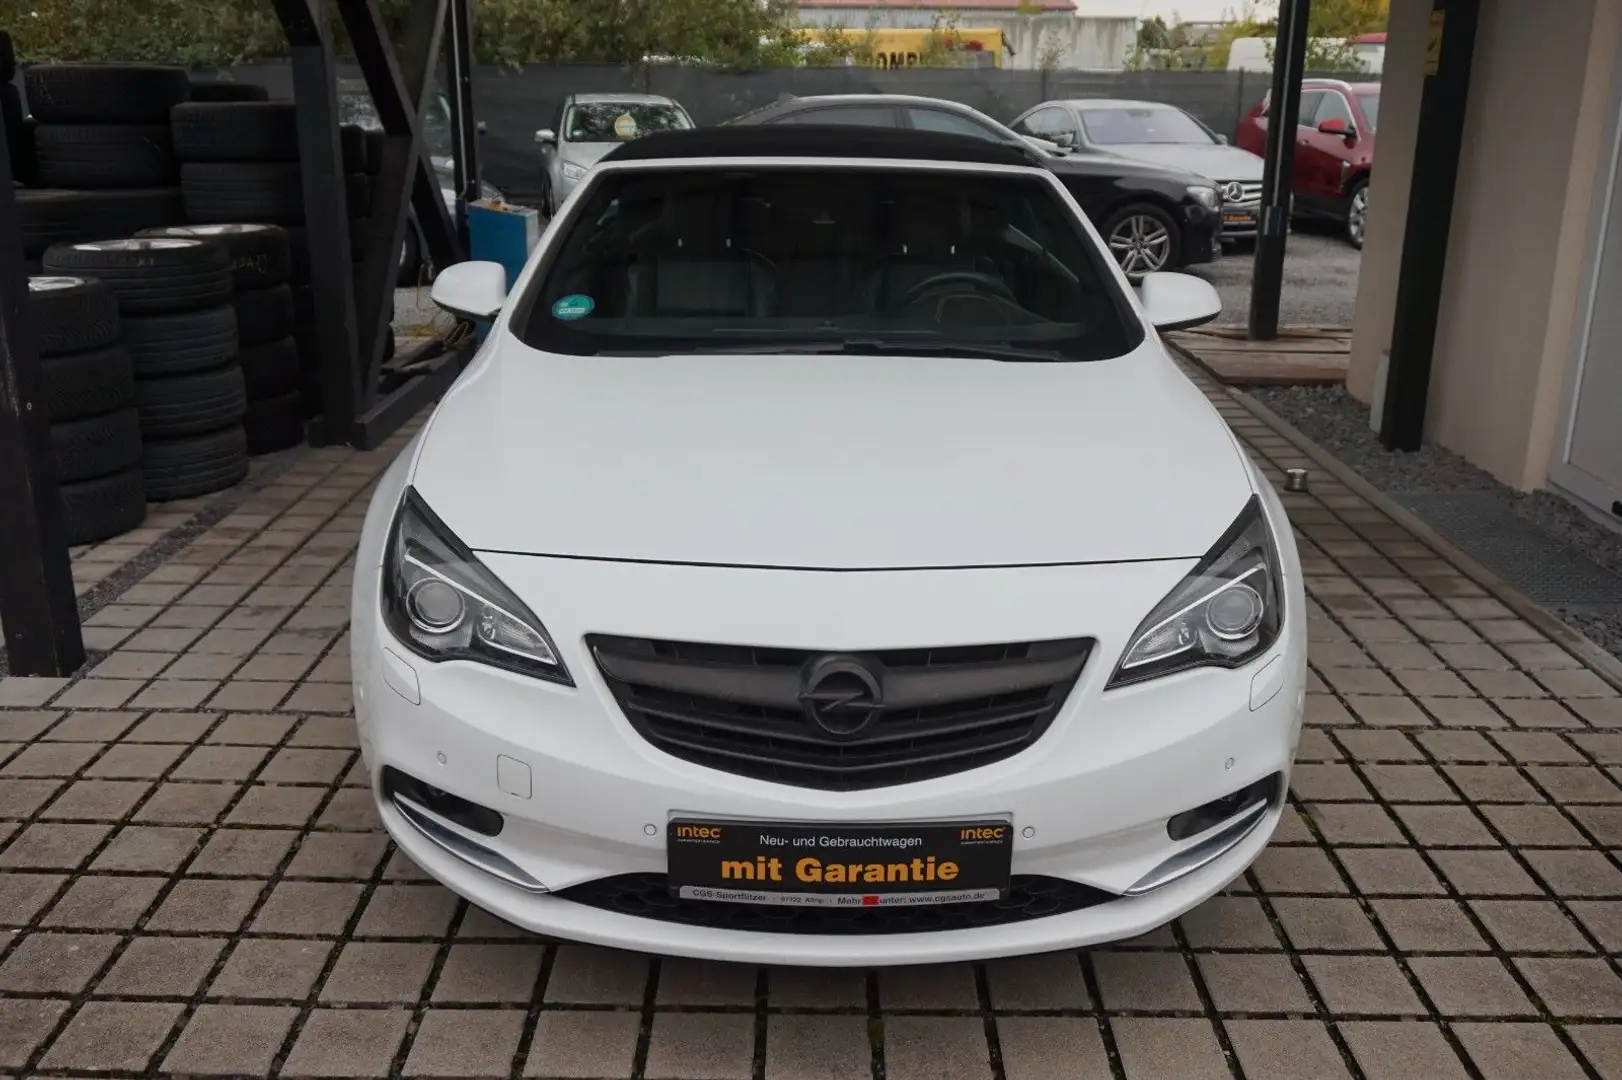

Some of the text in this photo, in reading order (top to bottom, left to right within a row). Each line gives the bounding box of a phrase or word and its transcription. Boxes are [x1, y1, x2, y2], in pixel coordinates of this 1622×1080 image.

[759, 834, 922, 849] Neu- und Gebrauchtwagen
[721, 855, 960, 883] mit Garantie
